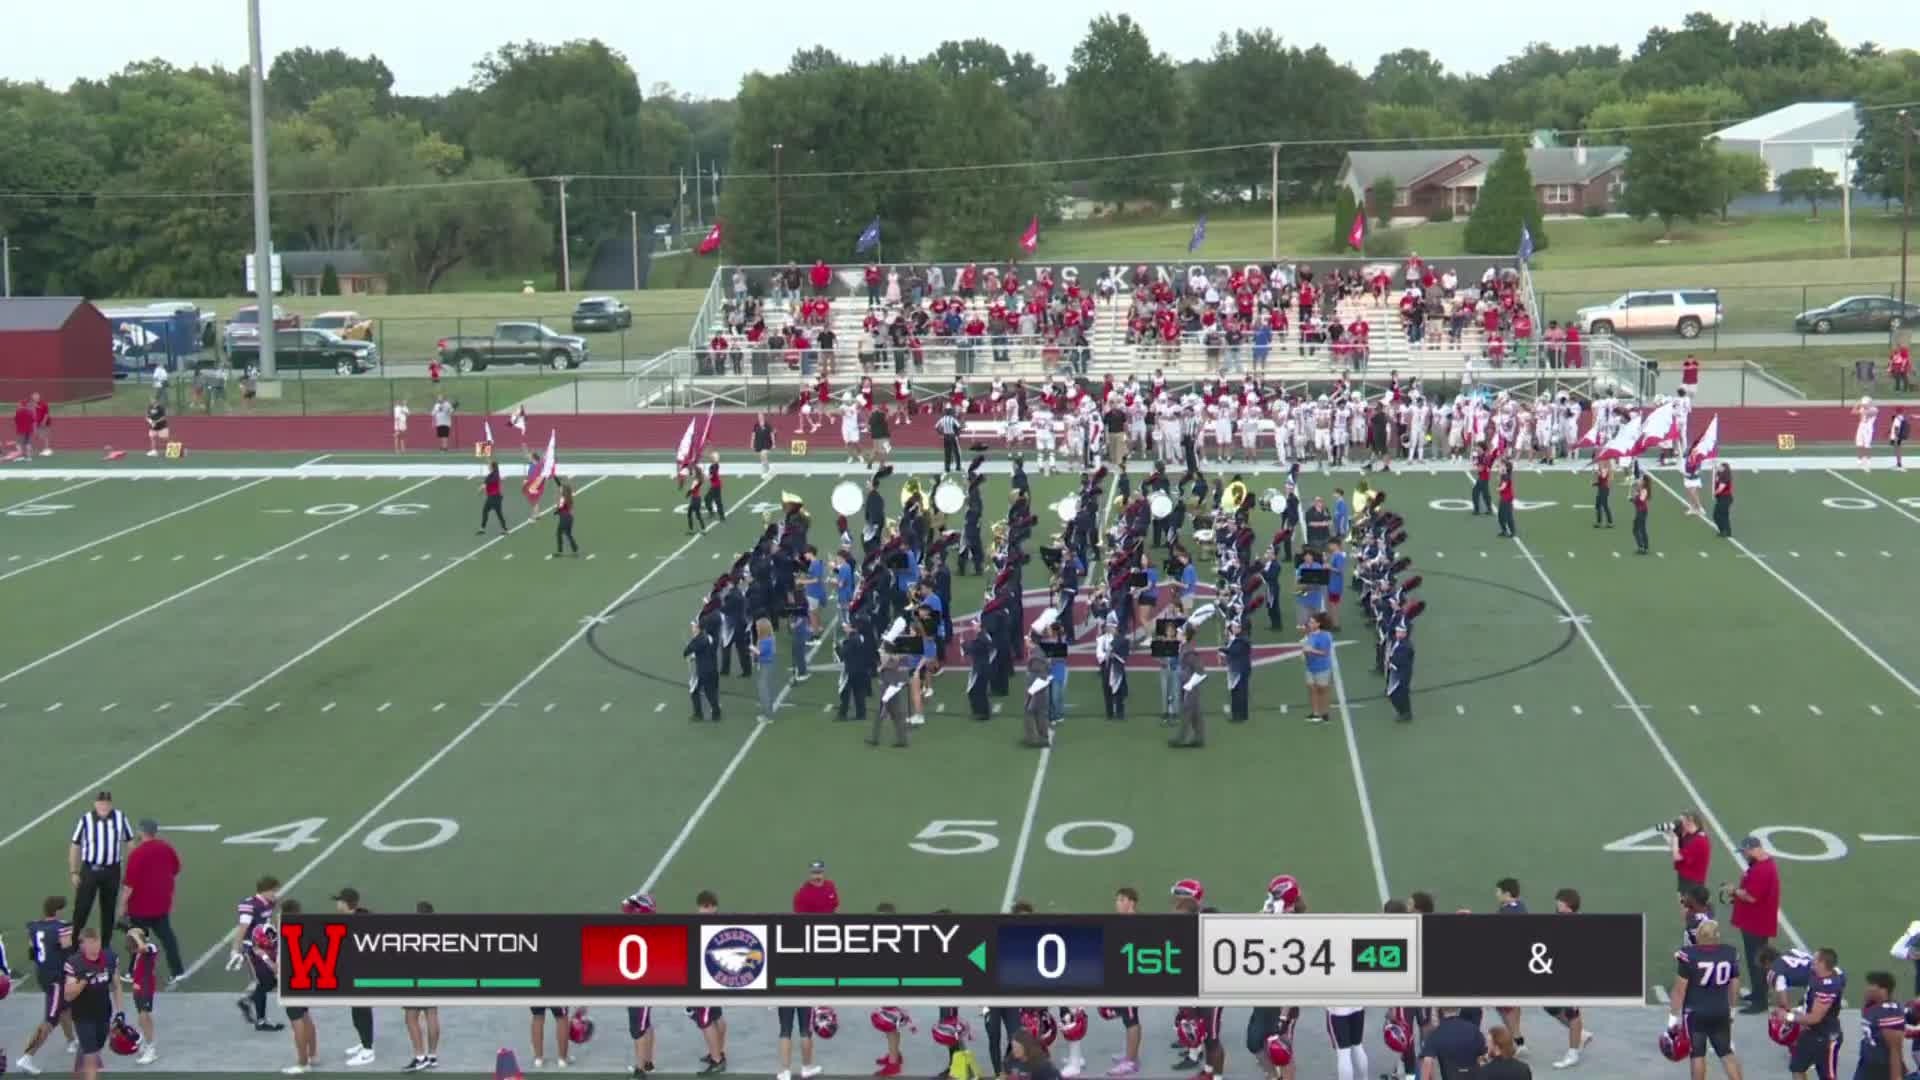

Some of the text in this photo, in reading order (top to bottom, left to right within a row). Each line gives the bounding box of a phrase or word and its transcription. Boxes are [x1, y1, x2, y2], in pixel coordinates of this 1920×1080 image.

[908, 820, 1134, 856] 50
[35, 930, 46, 963] 5
[1697, 961, 1732, 985] 70
